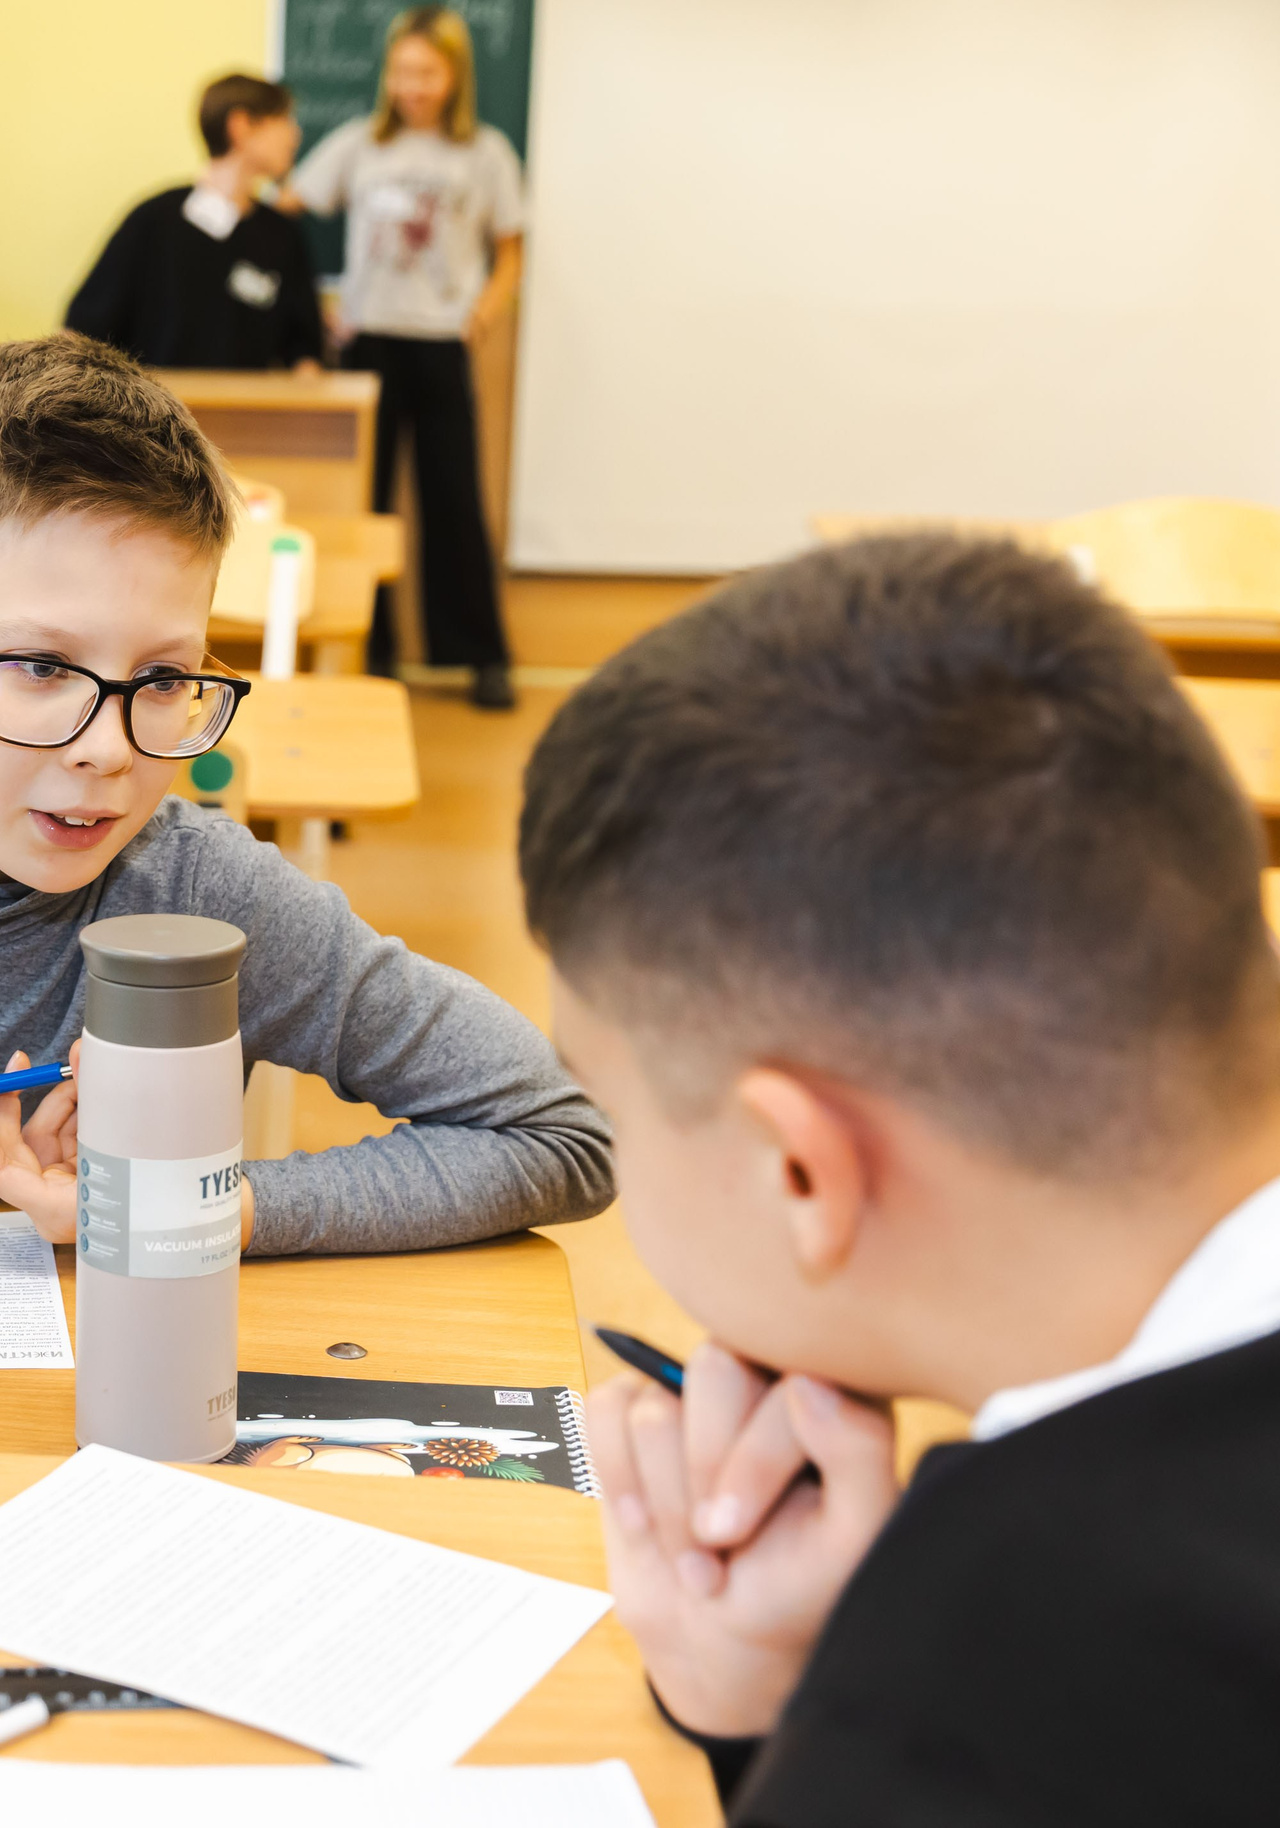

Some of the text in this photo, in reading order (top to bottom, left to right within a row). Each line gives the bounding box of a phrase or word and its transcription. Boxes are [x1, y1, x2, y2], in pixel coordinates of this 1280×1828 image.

[200, 1163, 241, 1199] TYES
[144, 1239, 201, 1252] VACUUM
[201, 1256, 210, 1264] 17
